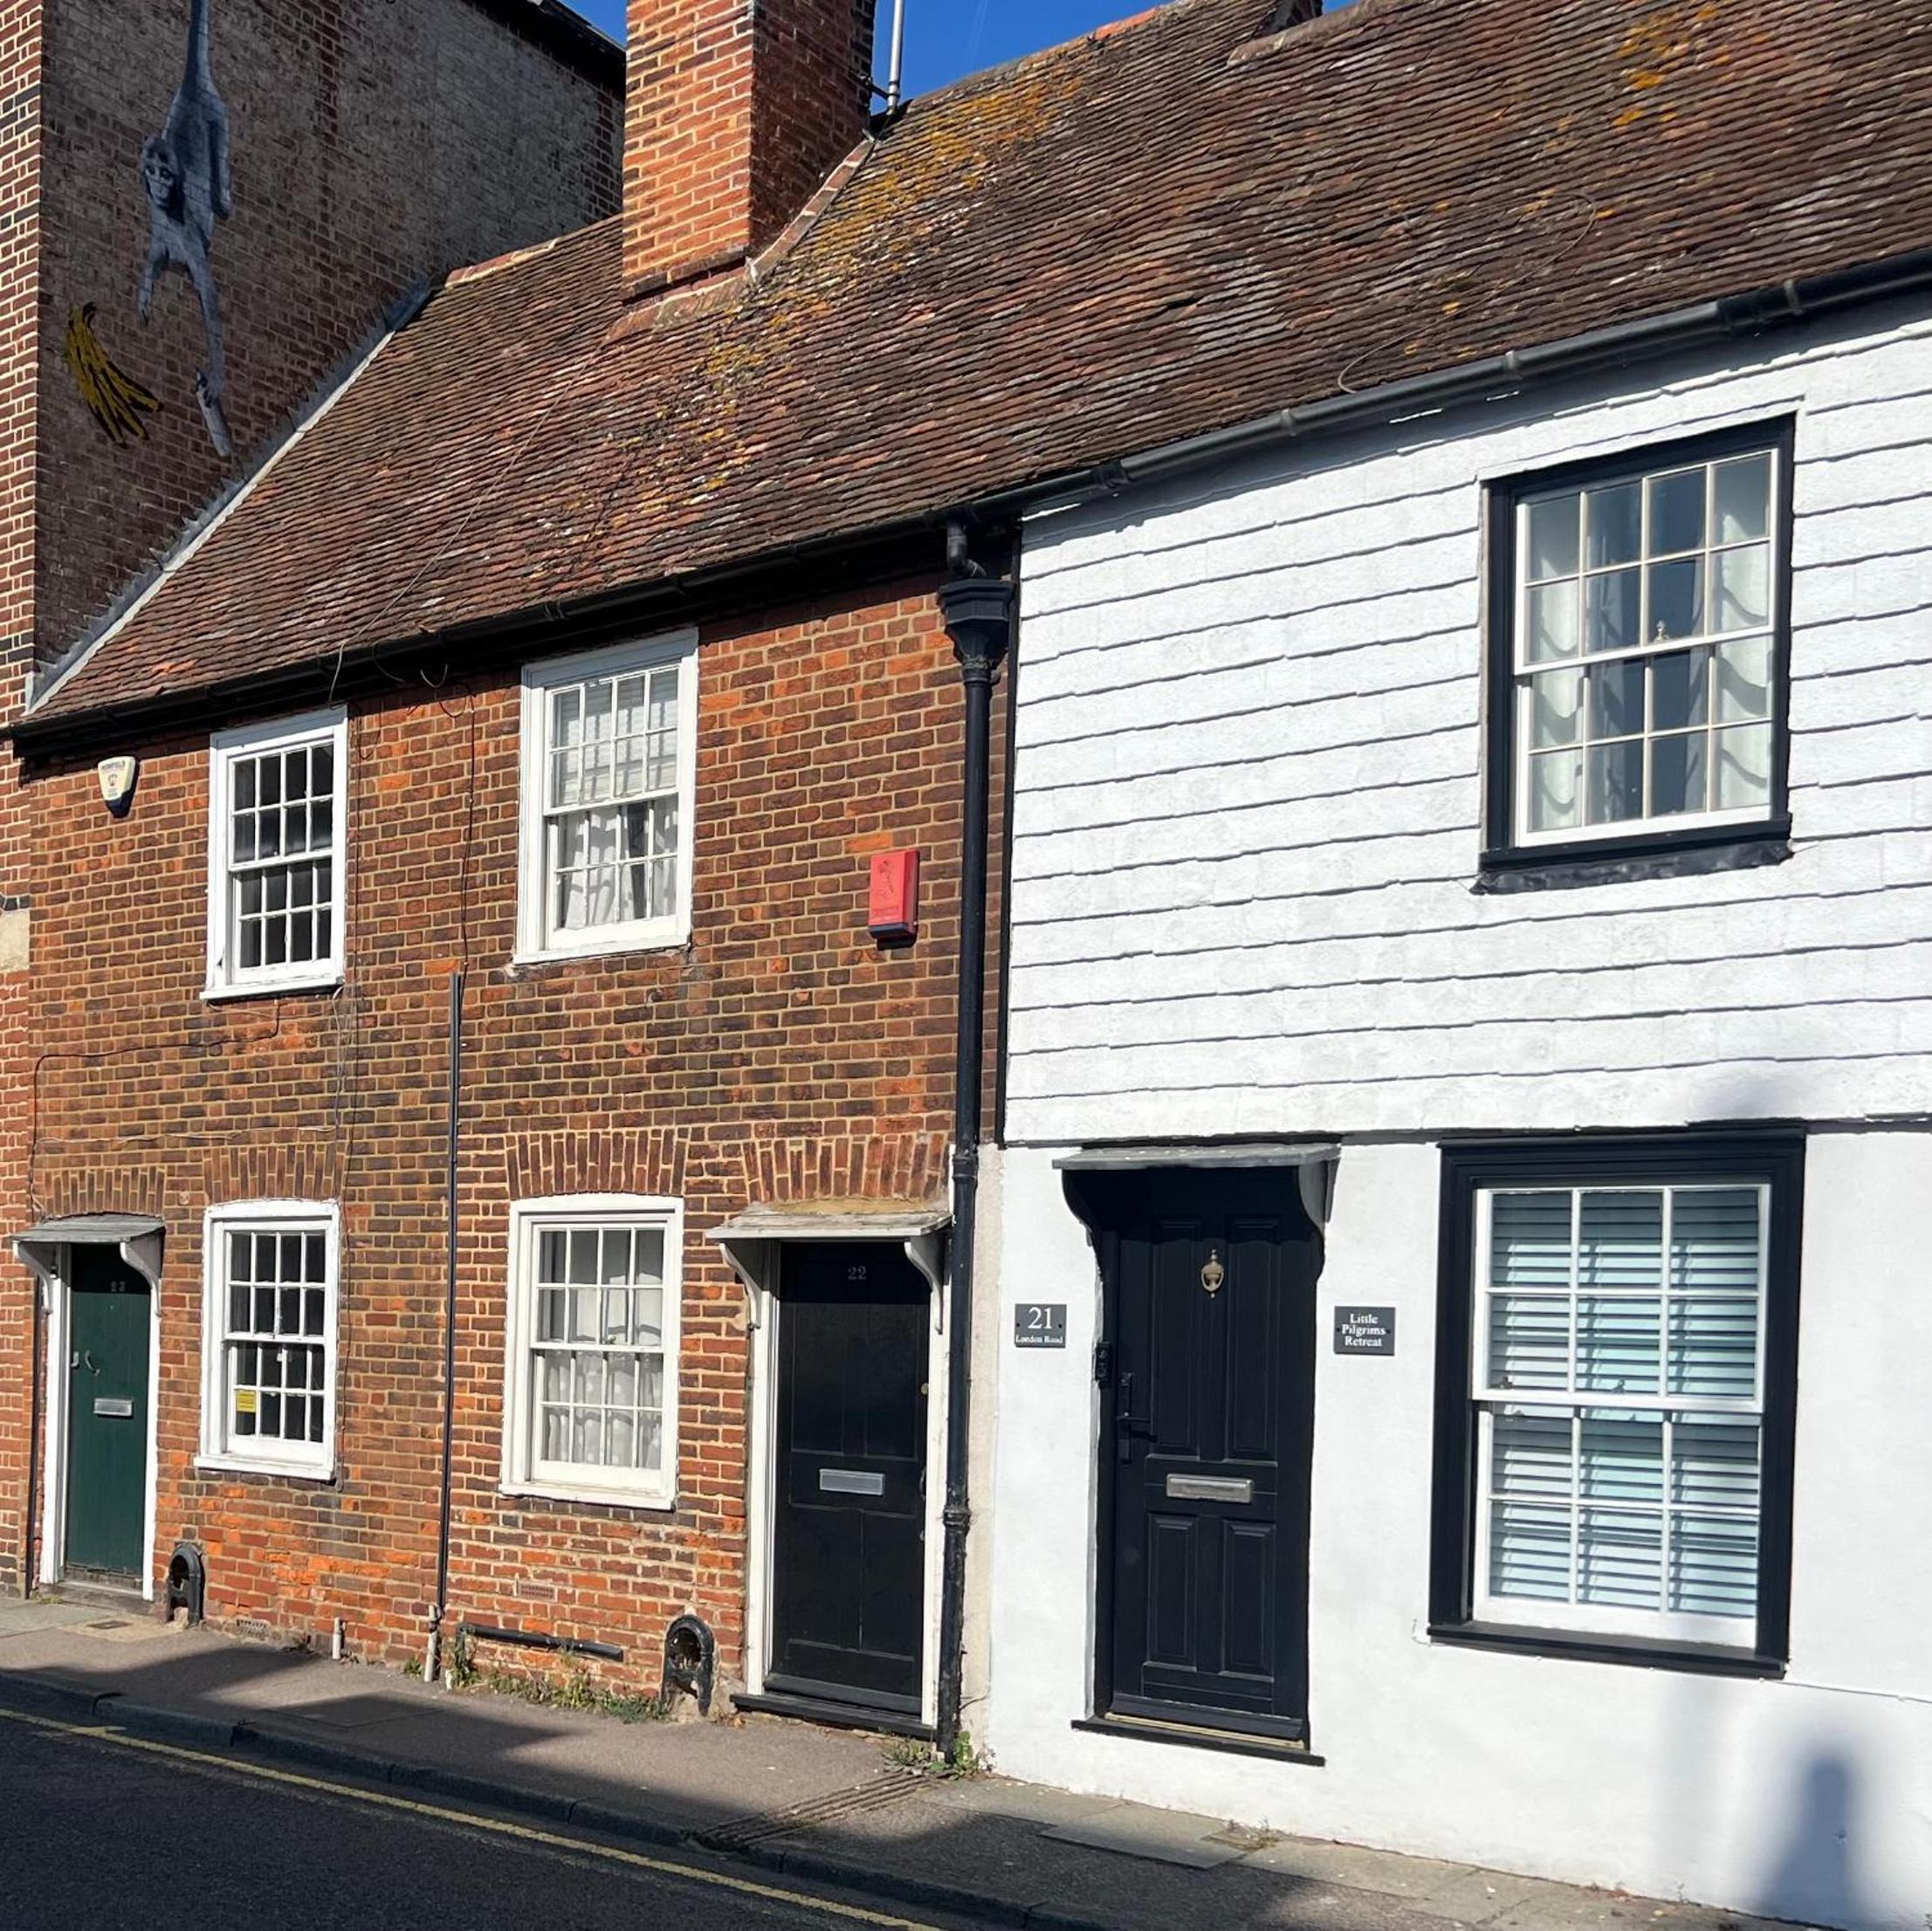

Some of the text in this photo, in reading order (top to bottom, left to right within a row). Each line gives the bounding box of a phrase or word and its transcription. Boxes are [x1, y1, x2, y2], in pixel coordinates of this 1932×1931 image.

[848, 1266, 867, 1281] 22
[1028, 1307, 1053, 1329] 21
[1350, 1313, 1379, 1324] Little
[1341, 1323, 1386, 1337] Pilgrims
[1345, 1336, 1382, 1347] Retreat
